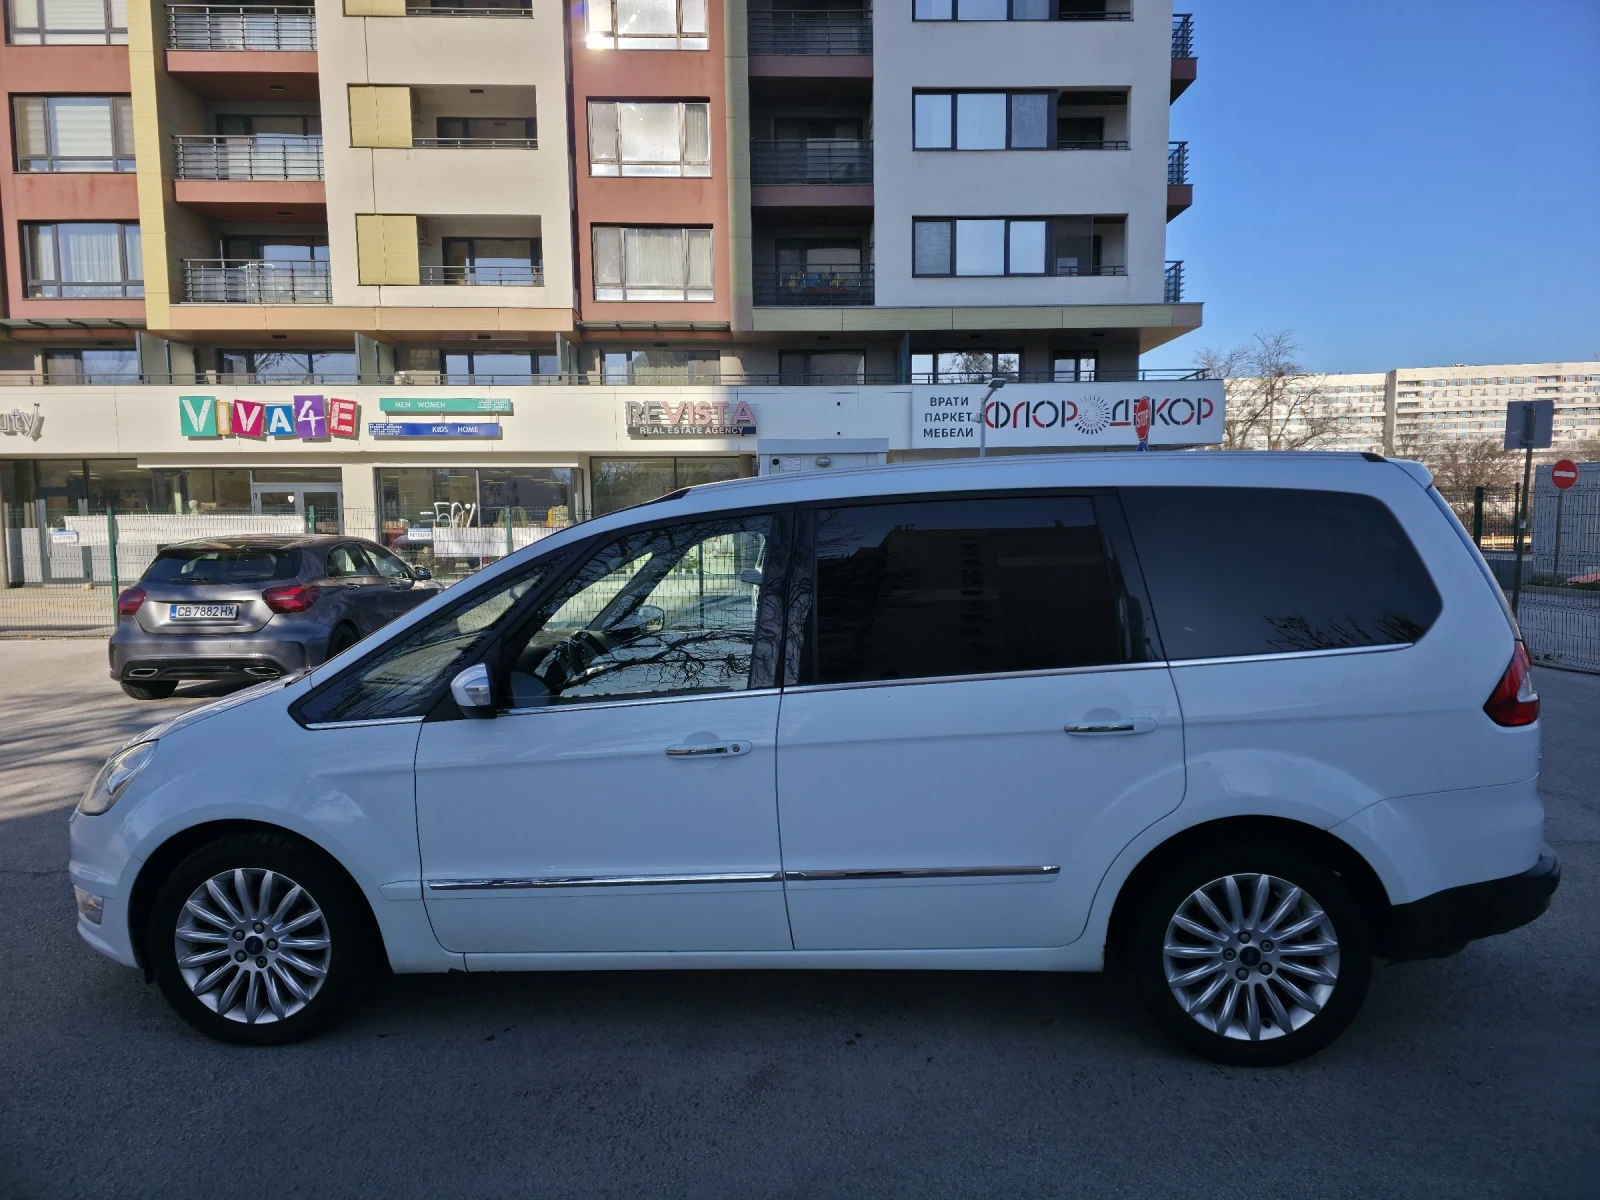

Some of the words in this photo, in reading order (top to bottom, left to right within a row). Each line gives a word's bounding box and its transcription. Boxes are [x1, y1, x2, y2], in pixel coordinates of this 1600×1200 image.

[930, 396, 969, 406] ВРАТИ
[181, 398, 355, 436] VIVA4E
[625, 400, 757, 425] REVISTA
[924, 412, 973, 422] ПАРКЕТ
[985, 400, 1078, 429] ФЛОР
[1109, 397, 1214, 427] ДКОР
[1136, 409, 1149, 428] STOP
[639, 426, 666, 434] REAL
[667, 426, 703, 434] ESTATE
[705, 426, 744, 434] AGENCY
[923, 427, 974, 438] МЕБЕЛИ
[178, 606, 192, 617] CB
[193, 606, 219, 617] 7882
[220, 606, 234, 617] HX
